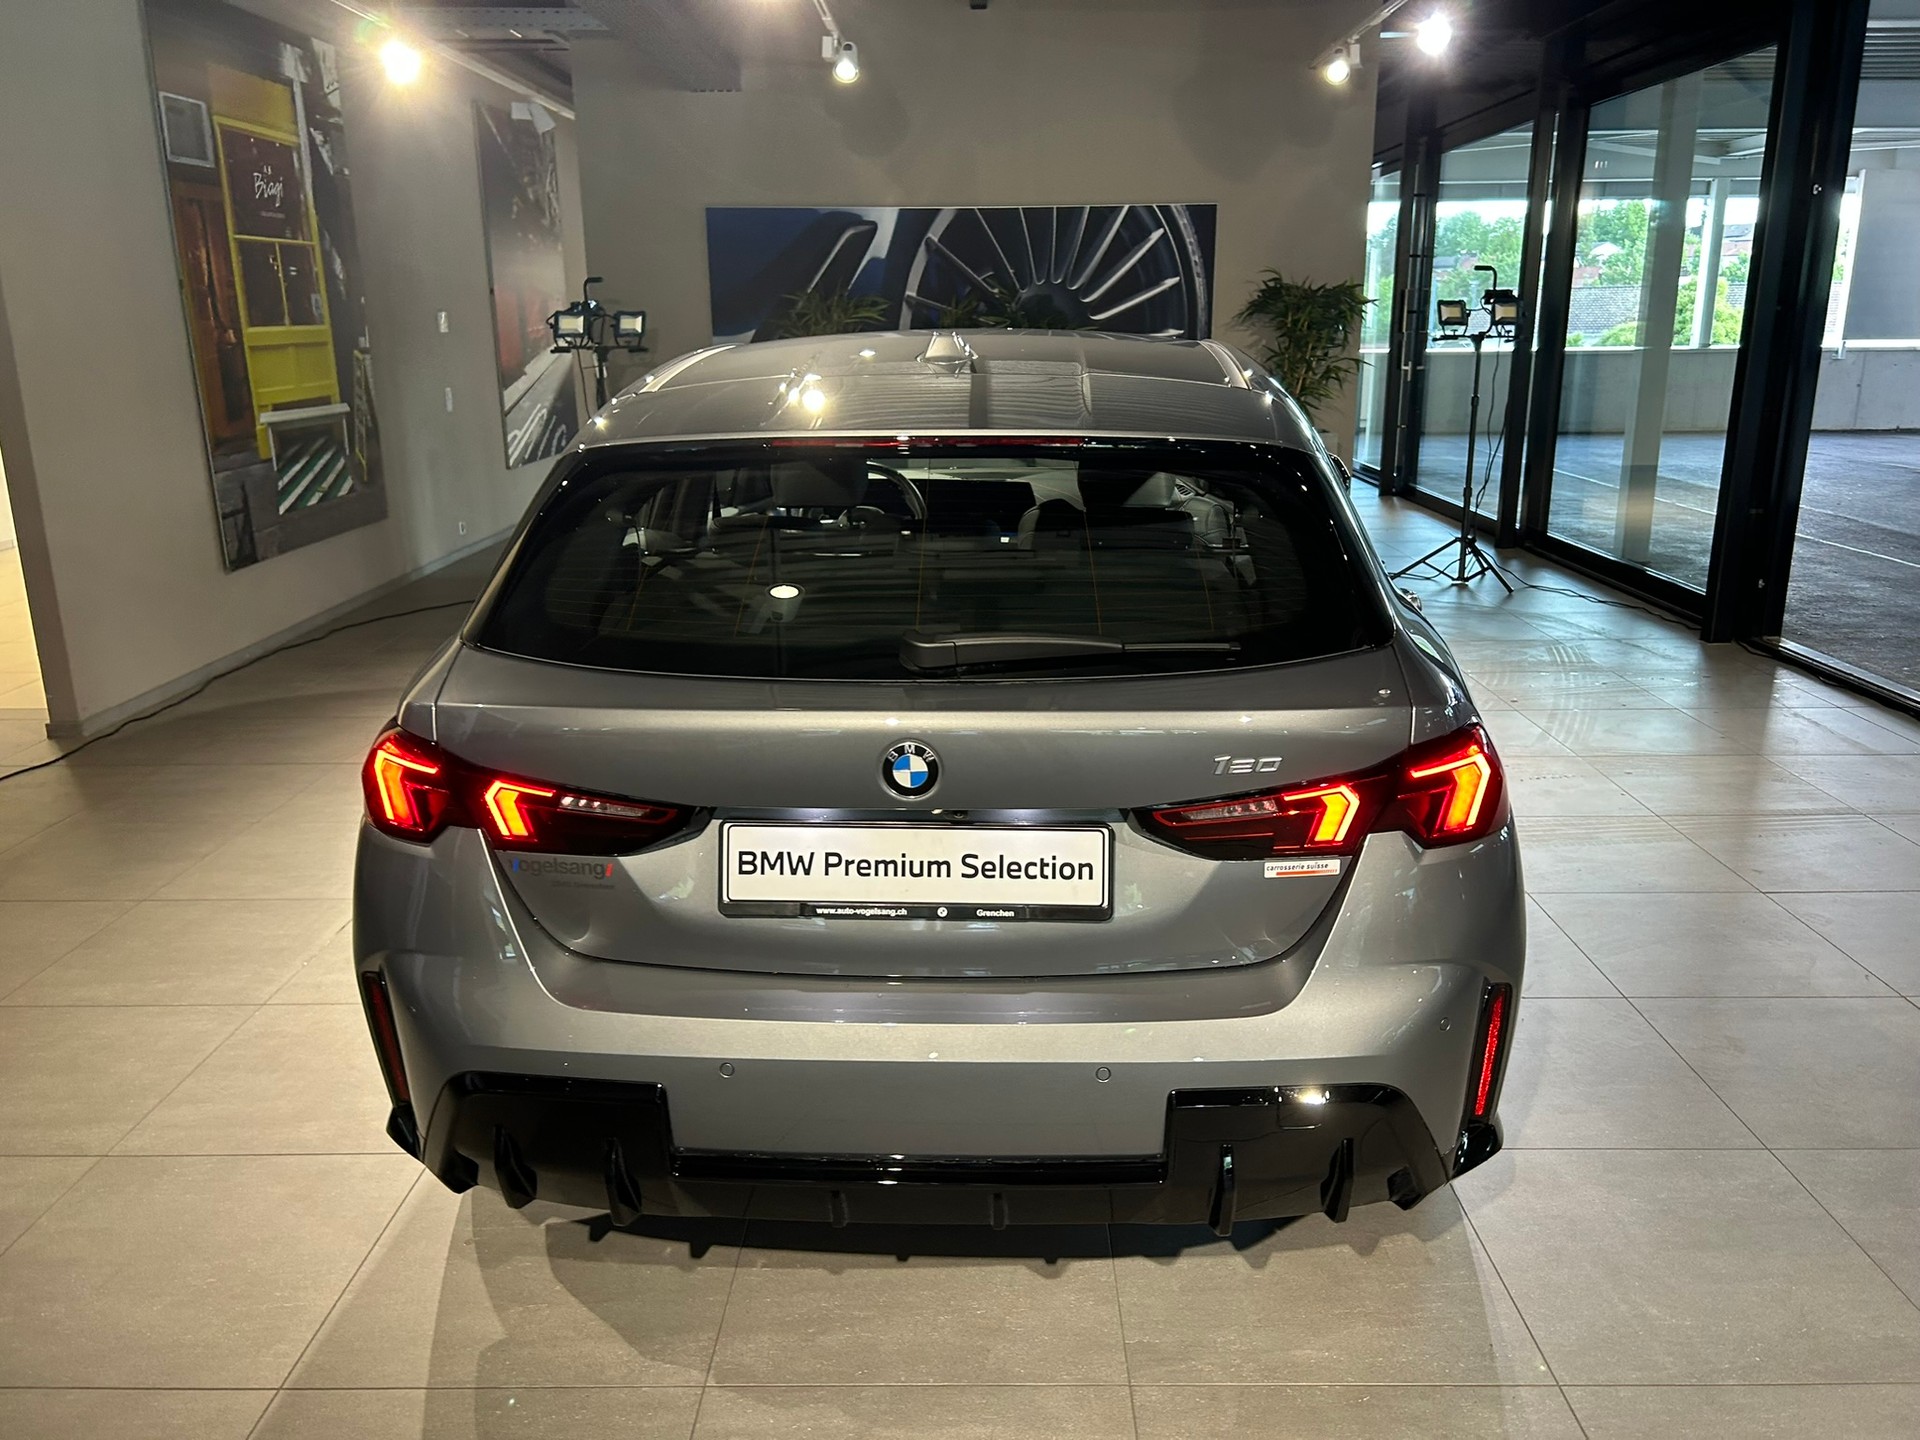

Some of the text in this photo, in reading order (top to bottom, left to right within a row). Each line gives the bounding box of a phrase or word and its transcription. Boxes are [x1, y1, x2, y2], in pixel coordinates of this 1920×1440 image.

[252, 172, 284, 207] Biagi
[888, 744, 935, 762] BMW
[1213, 755, 1283, 775] 120
[737, 850, 1095, 881] BMW Premium Selection
[1266, 863, 1305, 871] carrosserie
[816, 906, 908, 917] www.auto-vogelsang.ch
[976, 909, 1015, 918] Grenchen
